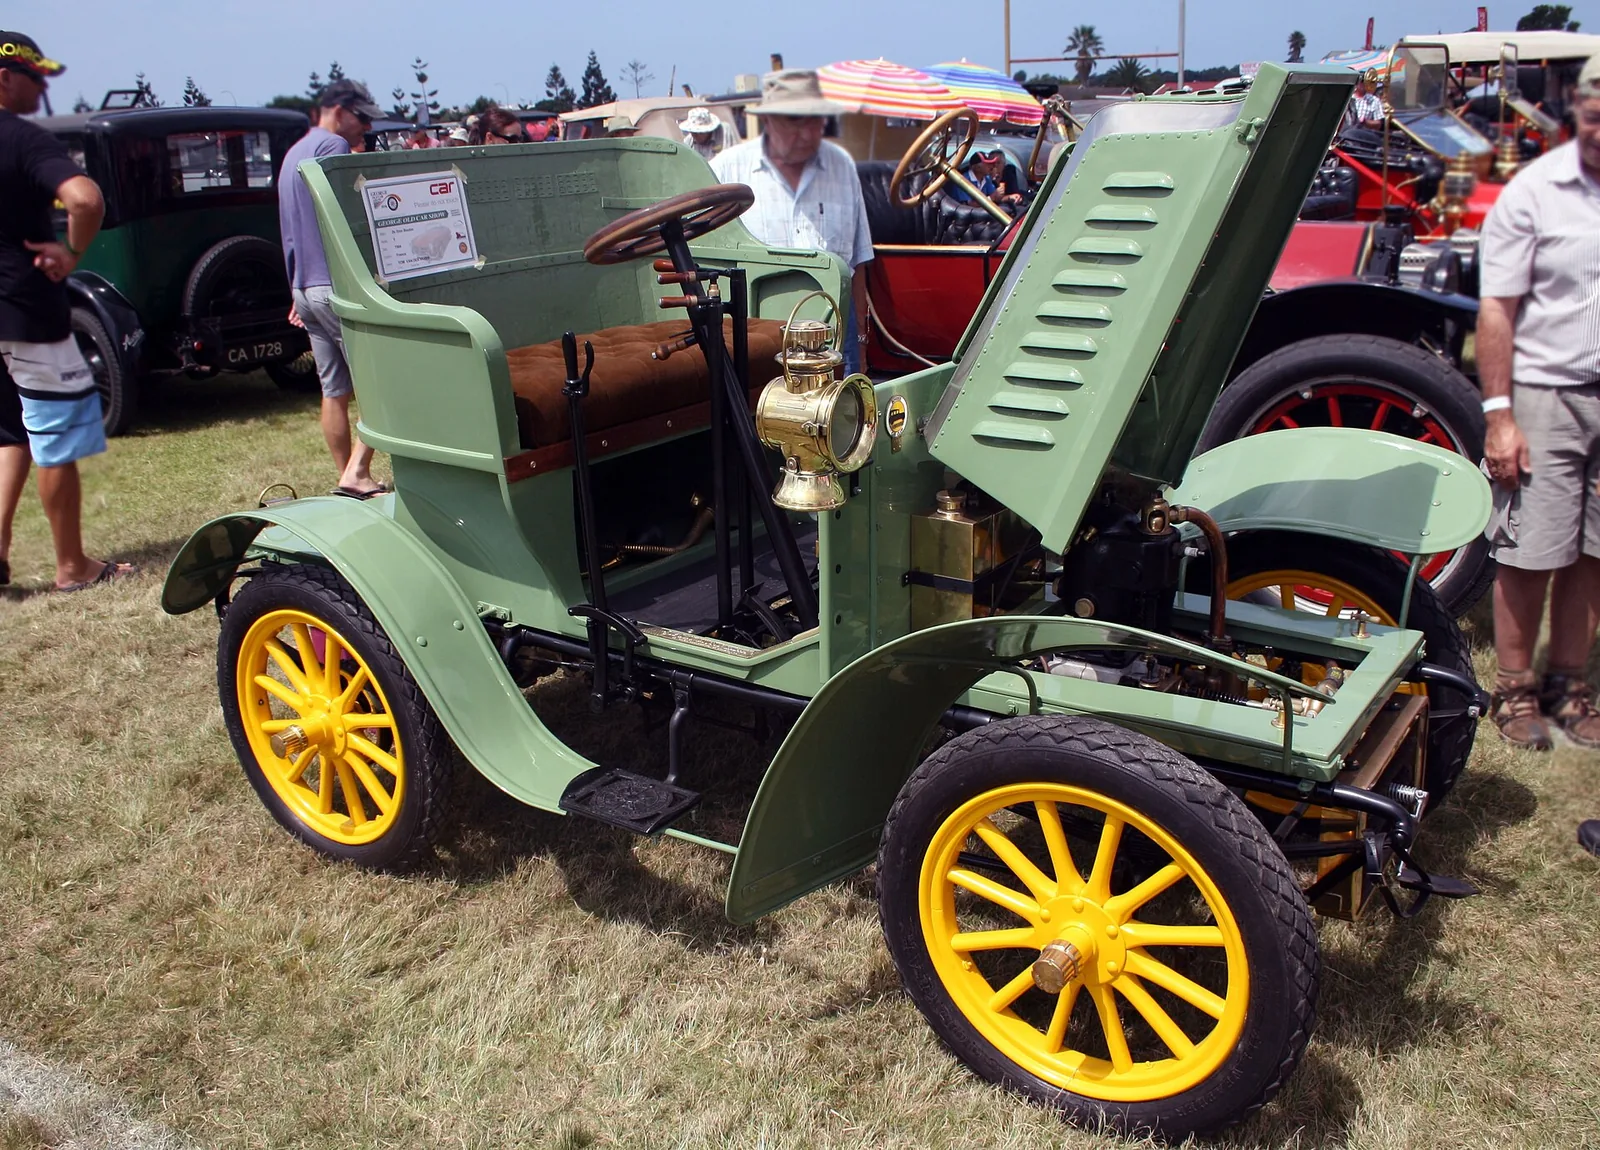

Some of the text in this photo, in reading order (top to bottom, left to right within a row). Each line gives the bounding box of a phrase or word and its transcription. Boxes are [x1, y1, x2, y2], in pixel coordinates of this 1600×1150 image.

[430, 182, 454, 196] car
[377, 217, 402, 227] GEORGE
[403, 216, 415, 224] OLD
[416, 214, 428, 222] CAR
[428, 211, 446, 220] SHOW
[228, 341, 283, 363] CA 1728
